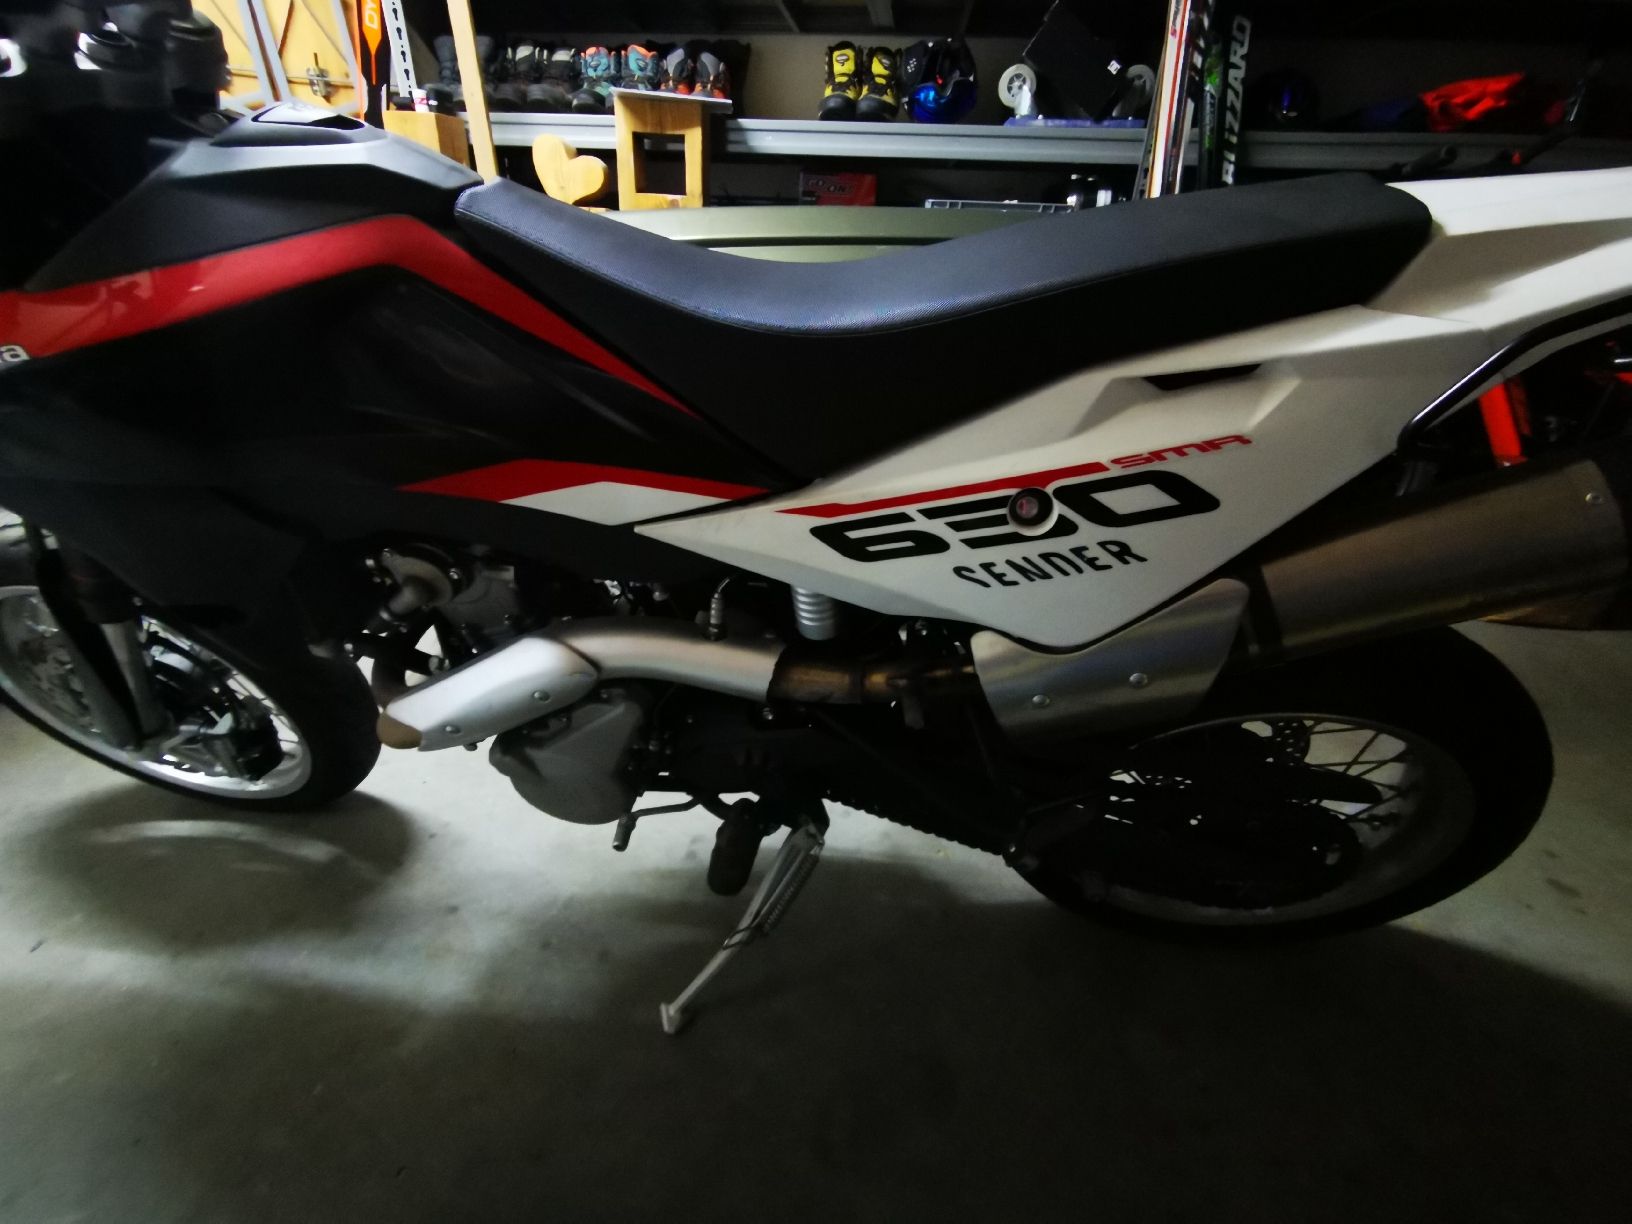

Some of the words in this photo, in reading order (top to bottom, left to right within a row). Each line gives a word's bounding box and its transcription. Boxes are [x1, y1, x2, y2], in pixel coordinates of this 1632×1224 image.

[1110, 434, 1252, 469] SMR
[810, 470, 1221, 562] 630
[952, 540, 1148, 588] SENDER
